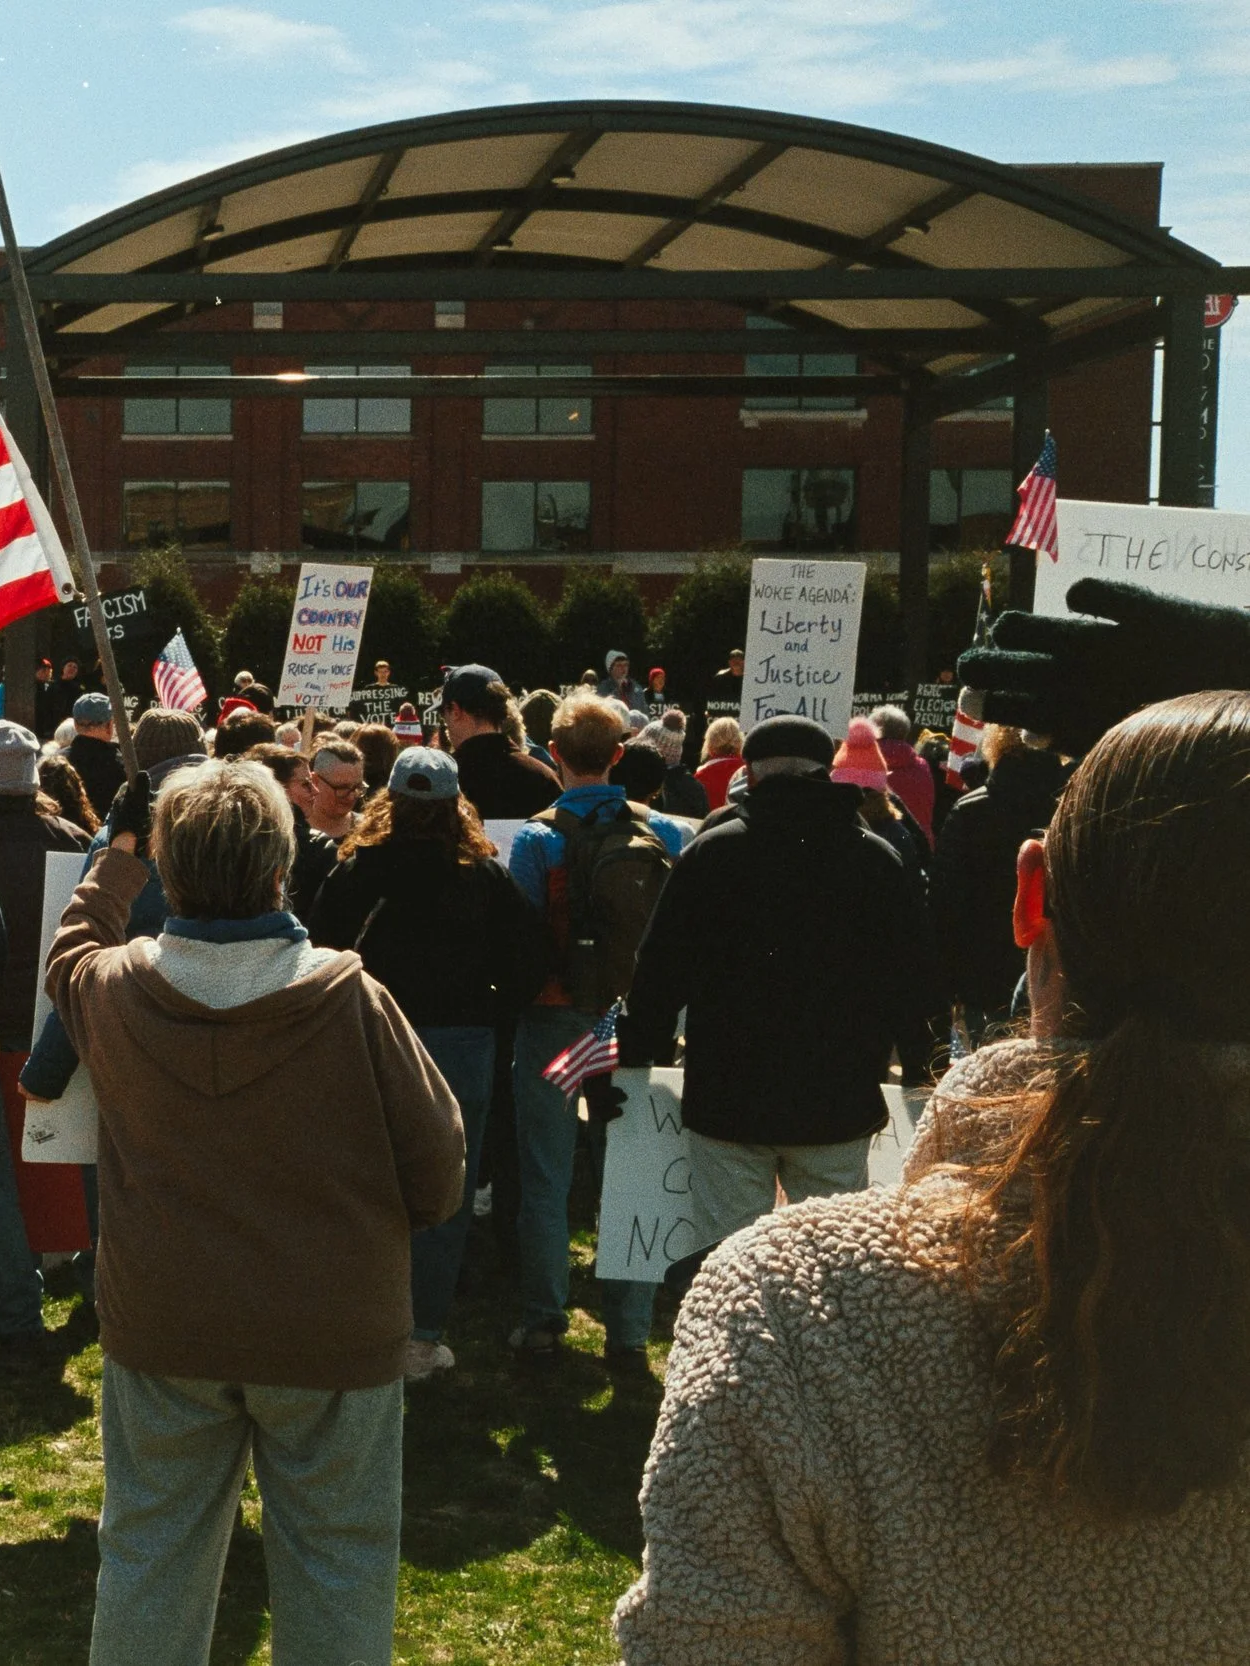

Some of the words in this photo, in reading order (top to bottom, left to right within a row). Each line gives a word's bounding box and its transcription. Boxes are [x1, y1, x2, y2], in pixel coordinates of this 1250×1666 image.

[1085, 533, 1168, 570] THE
[1192, 543, 1250, 572] CONS
[790, 563, 816, 578] THE
[299, 574, 331, 601] It's
[333, 580, 370, 600] OUR
[74, 590, 147, 628] FACISM
[296, 607, 364, 629] COUNTRY
[760, 610, 842, 642] Liberty
[292, 633, 327, 653] NOT
[332, 634, 355, 652] His
[784, 638, 809, 652] and
[288, 663, 317, 676] RAISE
[331, 664, 354, 676] VOICE
[755, 654, 841, 687] Justice
[364, 701, 392, 713] THE
[795, 696, 829, 722] All
[360, 712, 396, 725] VOTE
